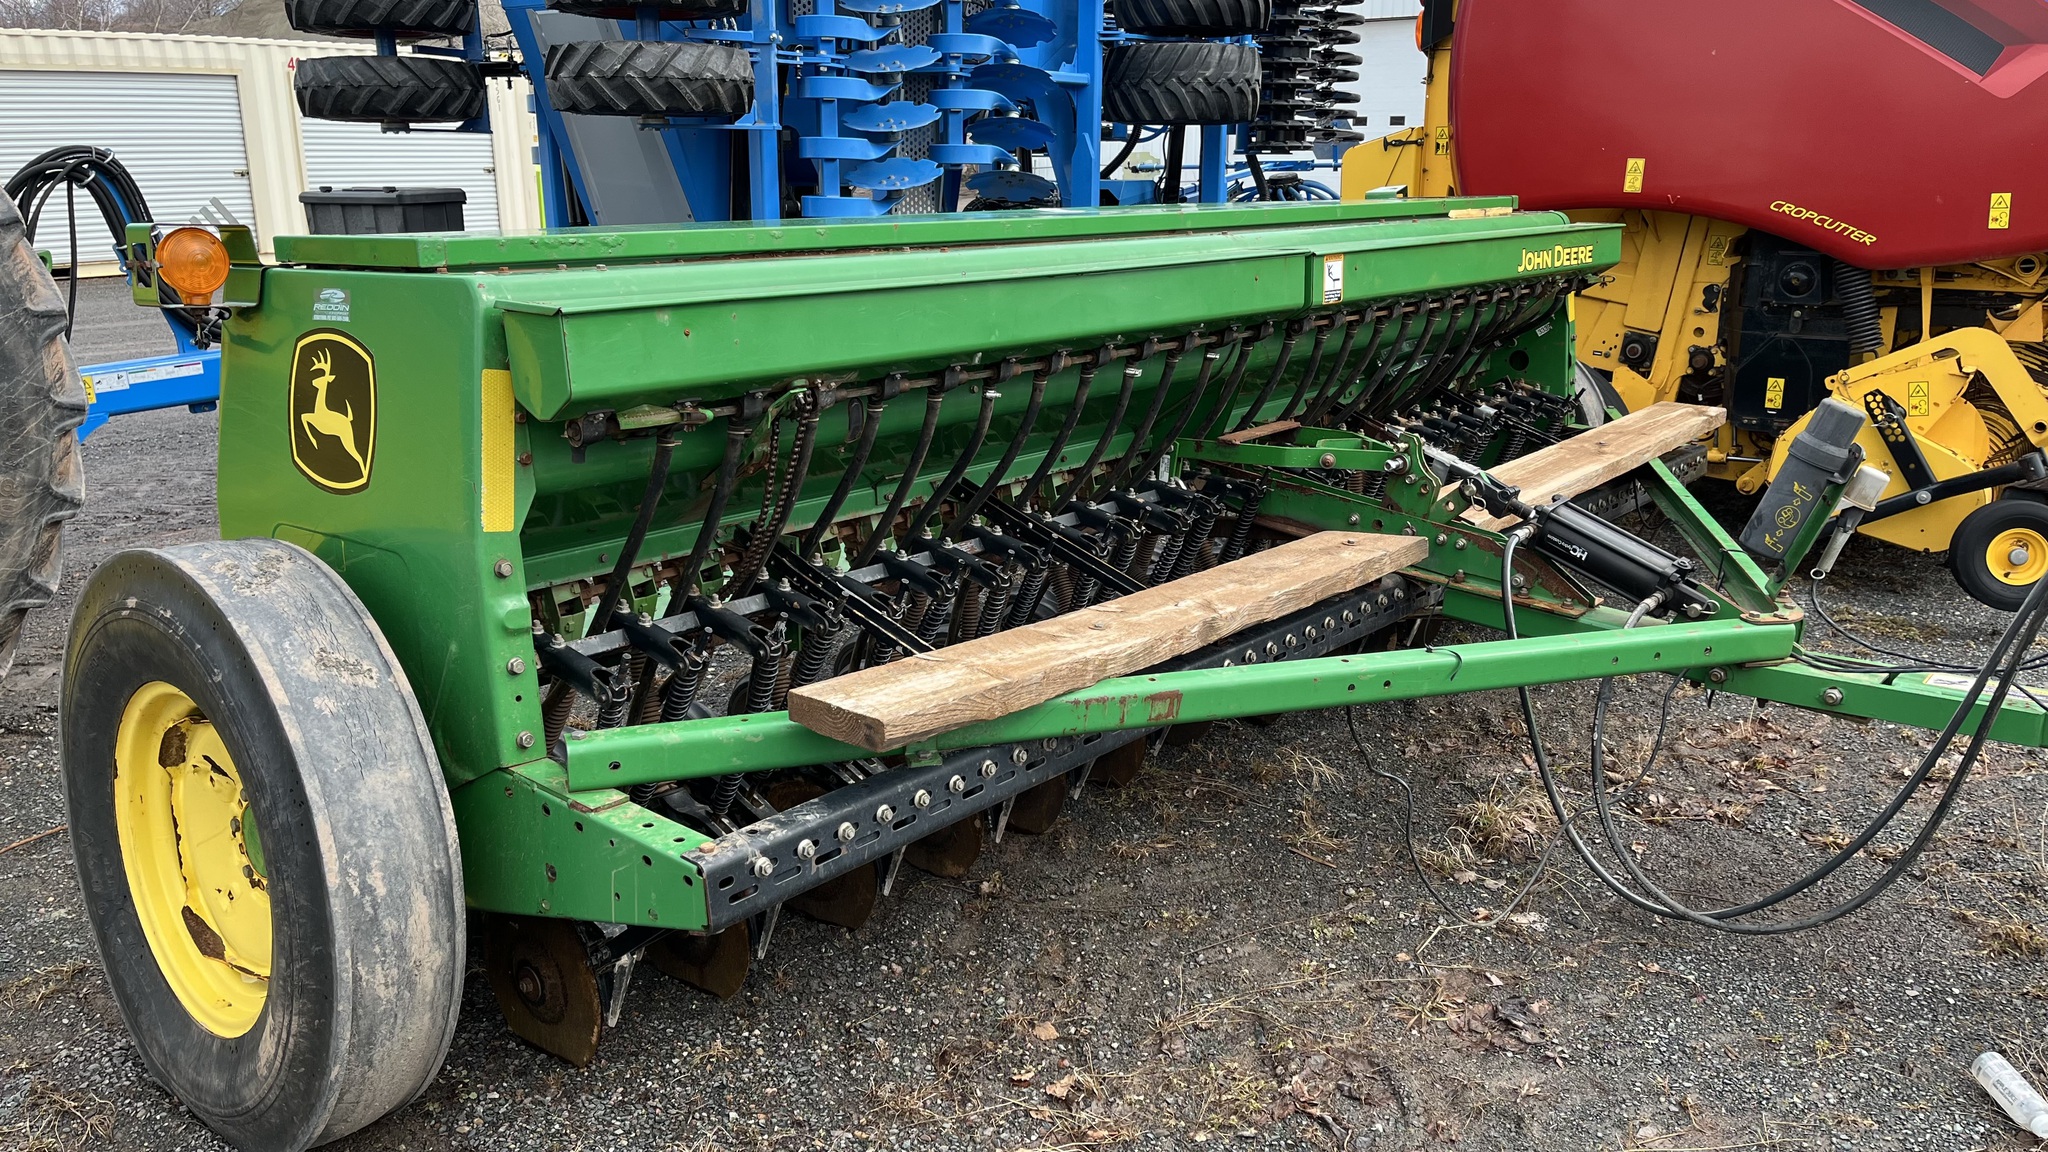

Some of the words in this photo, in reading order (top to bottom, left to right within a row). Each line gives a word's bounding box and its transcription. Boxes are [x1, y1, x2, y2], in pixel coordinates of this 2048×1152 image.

[1769, 200, 1878, 246] CROPCUTTER
[1517, 248, 1552, 273] JOHN
[1554, 244, 1594, 268] DEERE
